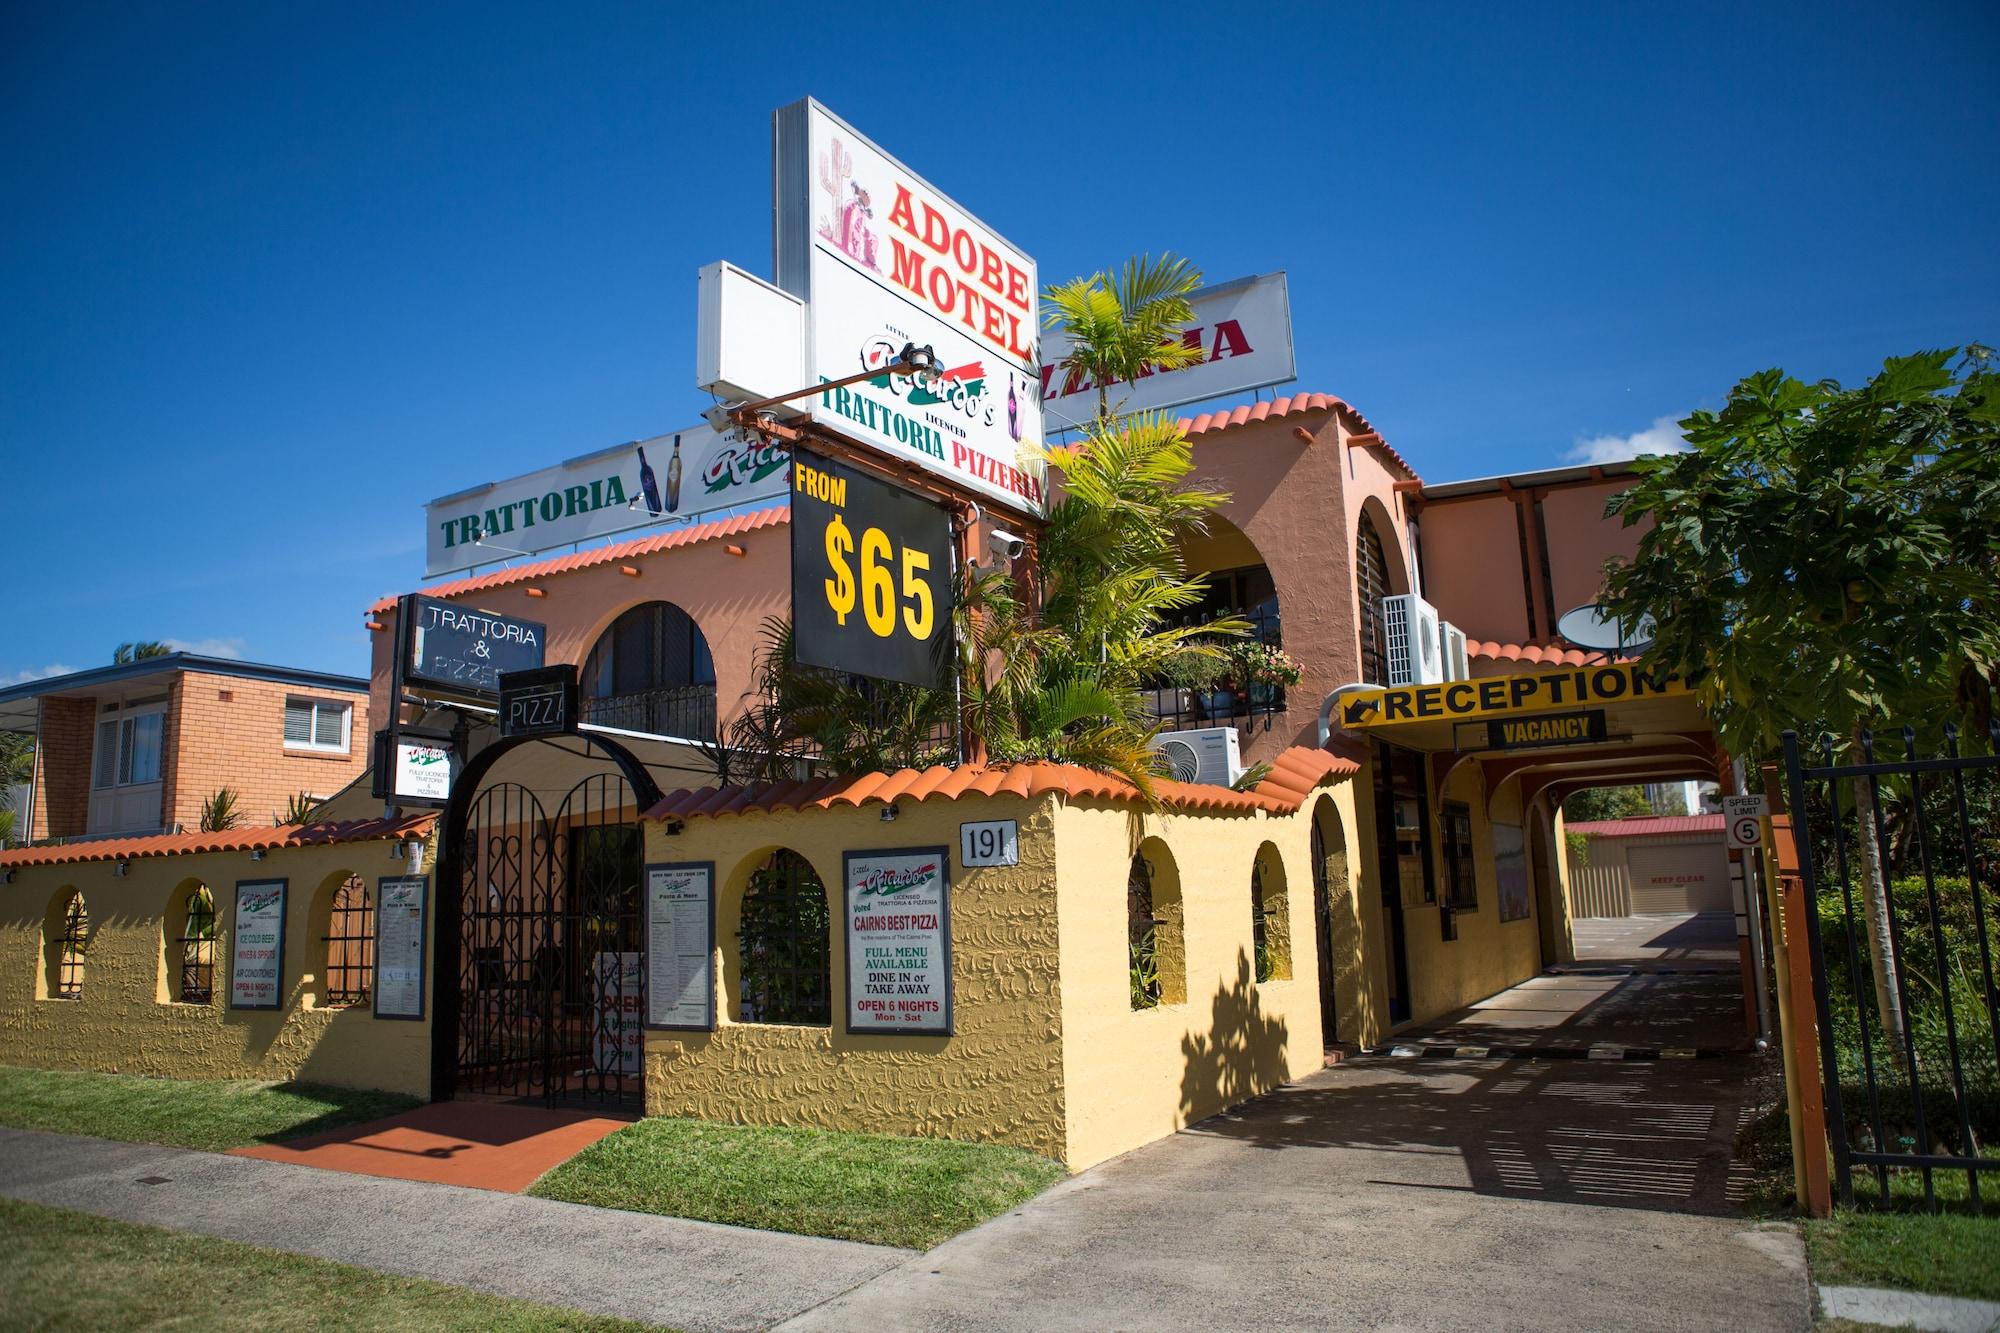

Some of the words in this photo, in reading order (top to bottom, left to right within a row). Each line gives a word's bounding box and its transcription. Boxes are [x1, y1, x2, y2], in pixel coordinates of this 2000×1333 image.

[888, 181, 1029, 313] ADOBE
[889, 236, 1032, 361] MOTEL
[925, 411, 967, 439] LICENCED
[819, 375, 946, 461] TRATTORIA
[952, 440, 1043, 505] PIZZERIA
[795, 462, 847, 508] FROM
[441, 475, 626, 549] TRATTORIA
[824, 513, 934, 641] $65
[424, 606, 537, 648] TRATTORIA
[474, 640, 490, 660] &
[1384, 664, 1666, 720] RECEPTION
[1503, 716, 1590, 744] VACANCY
[1729, 797, 1761, 807] SPEED
[1734, 807, 1758, 816] LIMIT
[1742, 823, 1754, 839] 5
[969, 826, 1005, 859] 191
[854, 903, 871, 913] Voted
[854, 915, 886, 930] CAIRNS
[887, 914, 910, 930] BEST
[912, 914, 938, 929] PIZZA
[865, 948, 892, 957] FULL
[895, 947, 928, 957] MENU
[865, 959, 928, 969] AVAILABLE
[868, 973, 895, 983] DINE
[899, 972, 911, 983] IN
[914, 974, 925, 983] or
[865, 984, 895, 994] TAKE
[897, 984, 930, 994] AWAY
[858, 1000, 886, 1011] OPEN
[889, 1000, 895, 1011] 6
[898, 1000, 939, 1012] NIGHTS
[875, 1012, 896, 1022] Mon
[905, 1013, 922, 1022] Sat
